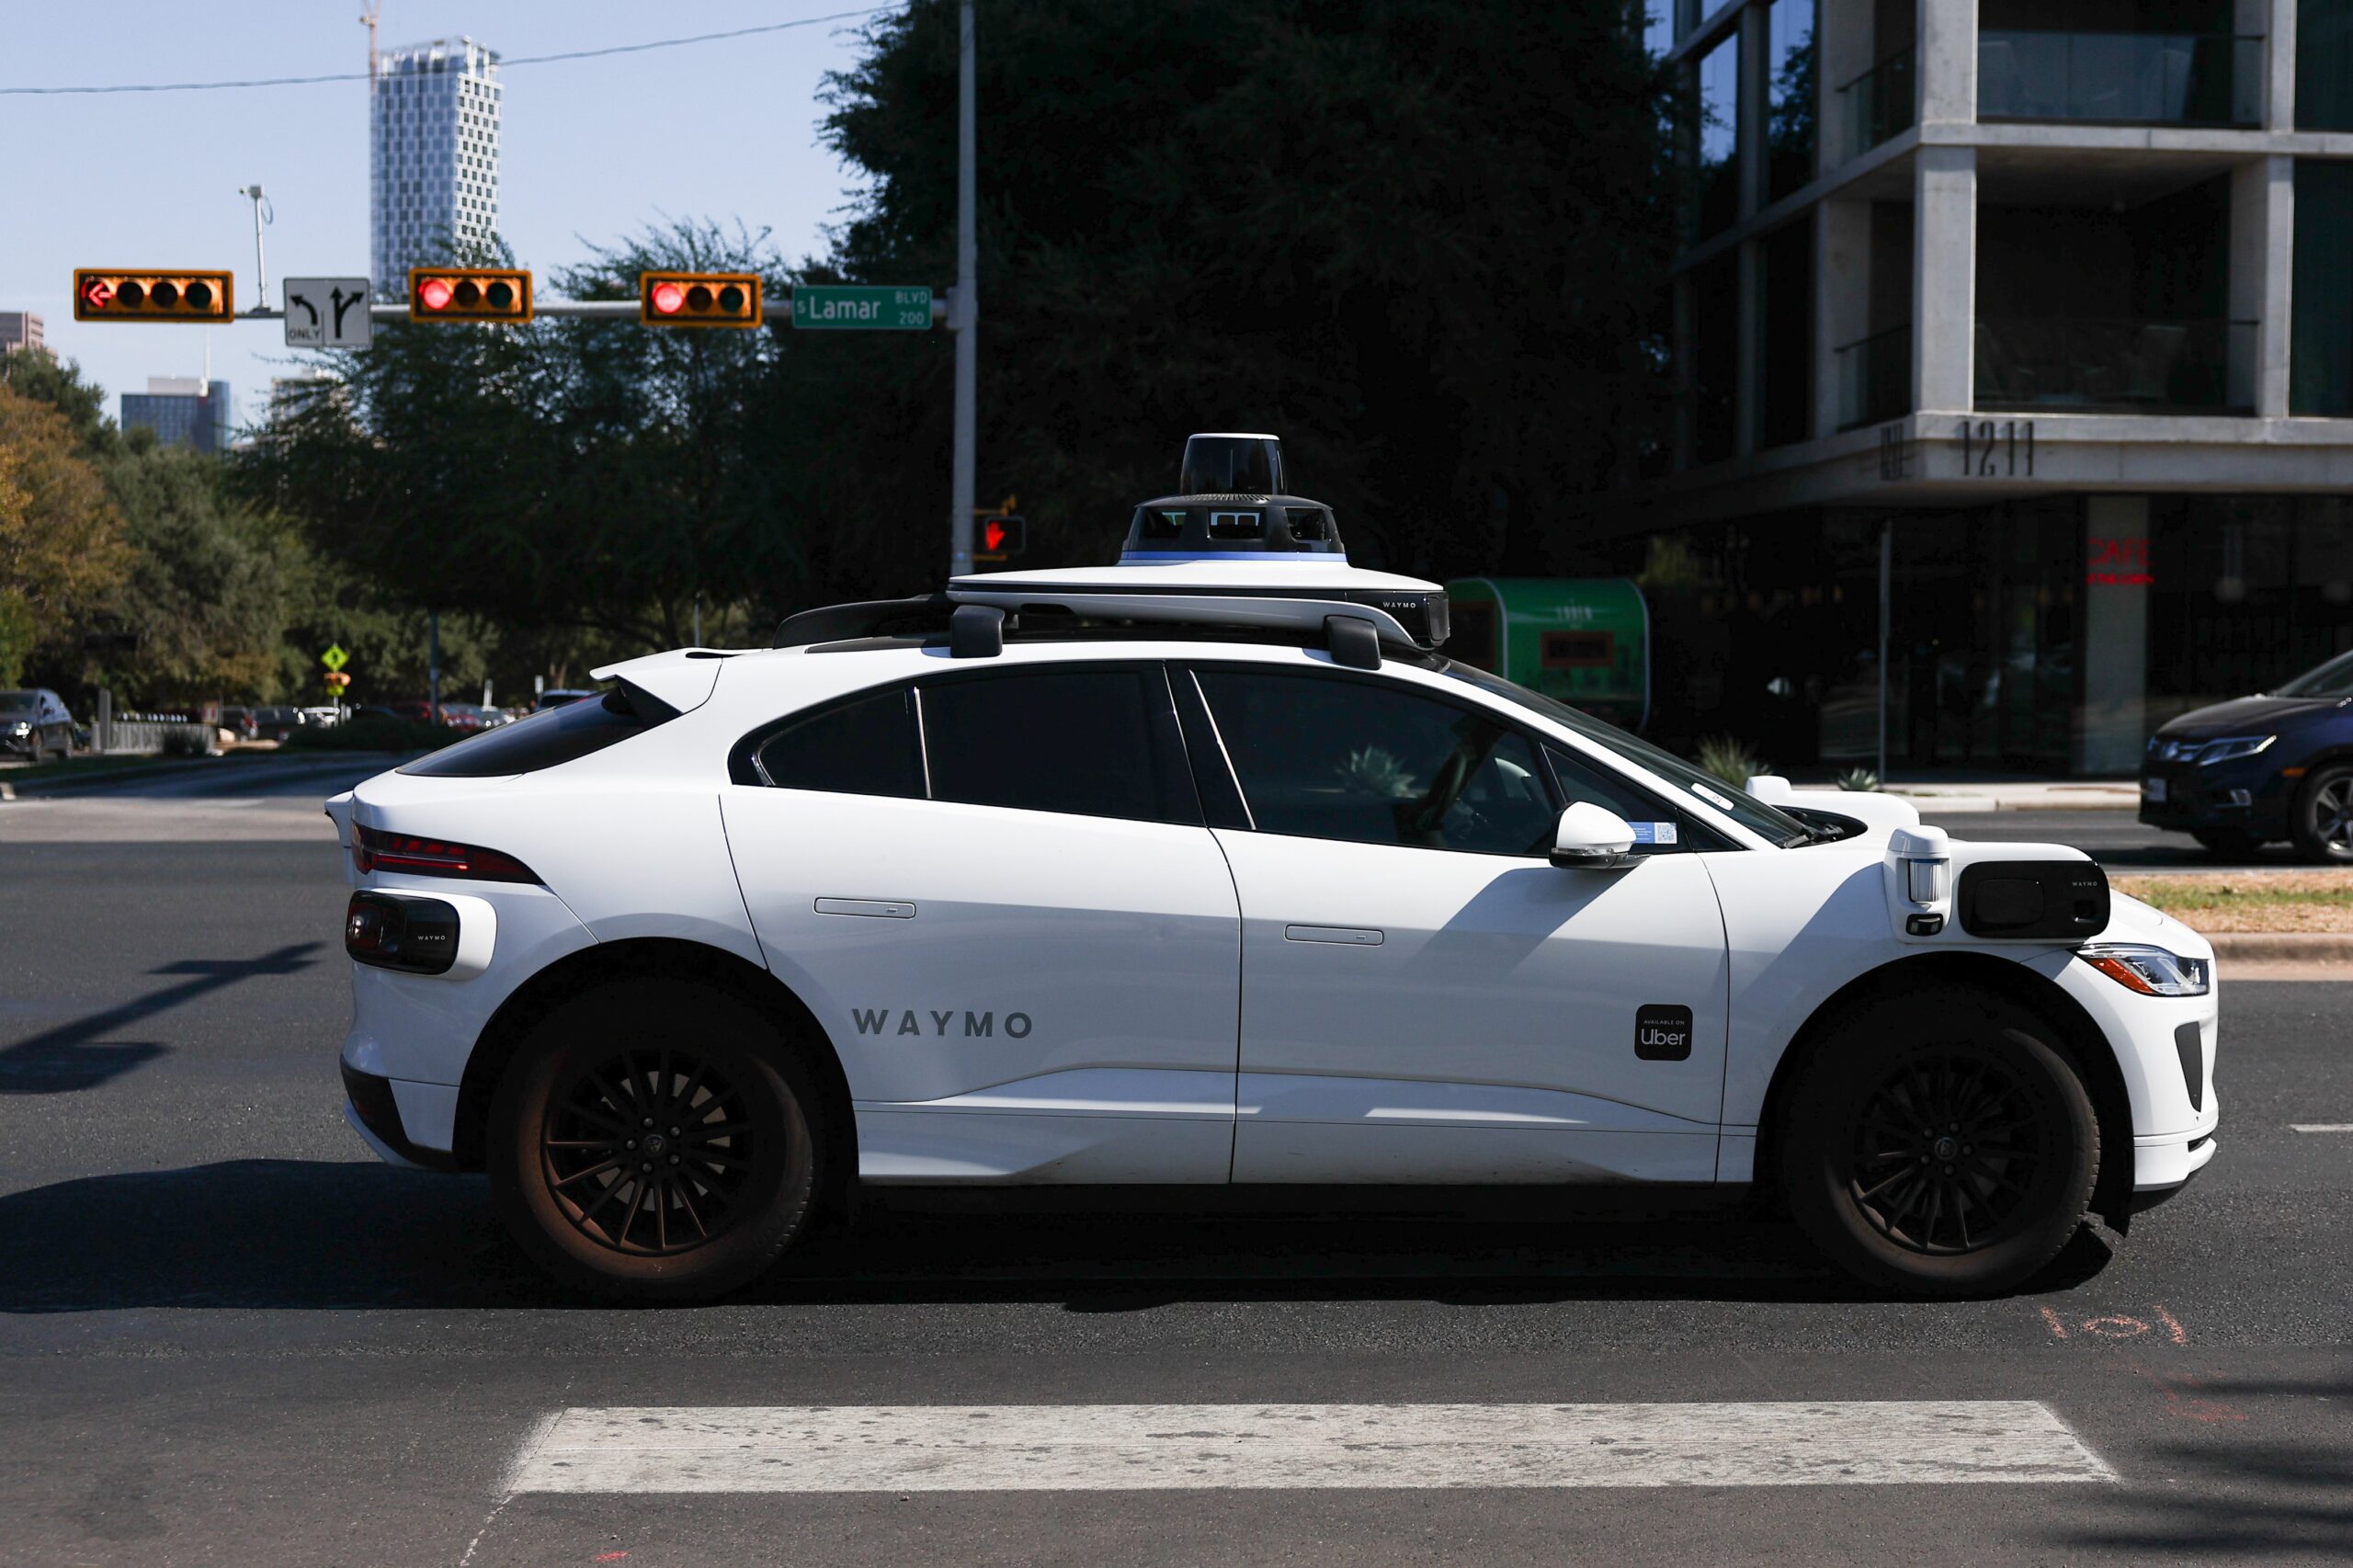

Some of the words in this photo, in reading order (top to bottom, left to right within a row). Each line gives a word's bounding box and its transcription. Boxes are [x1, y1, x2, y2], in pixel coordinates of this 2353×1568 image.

[895, 290, 928, 304] BLVD
[810, 295, 881, 320] Lamar
[899, 312, 925, 324] 200
[289, 327, 321, 340] ONLY
[1962, 421, 2034, 476] 1211
[851, 1008, 1032, 1039] WAYMO
[1641, 1028, 1686, 1046] Uber
